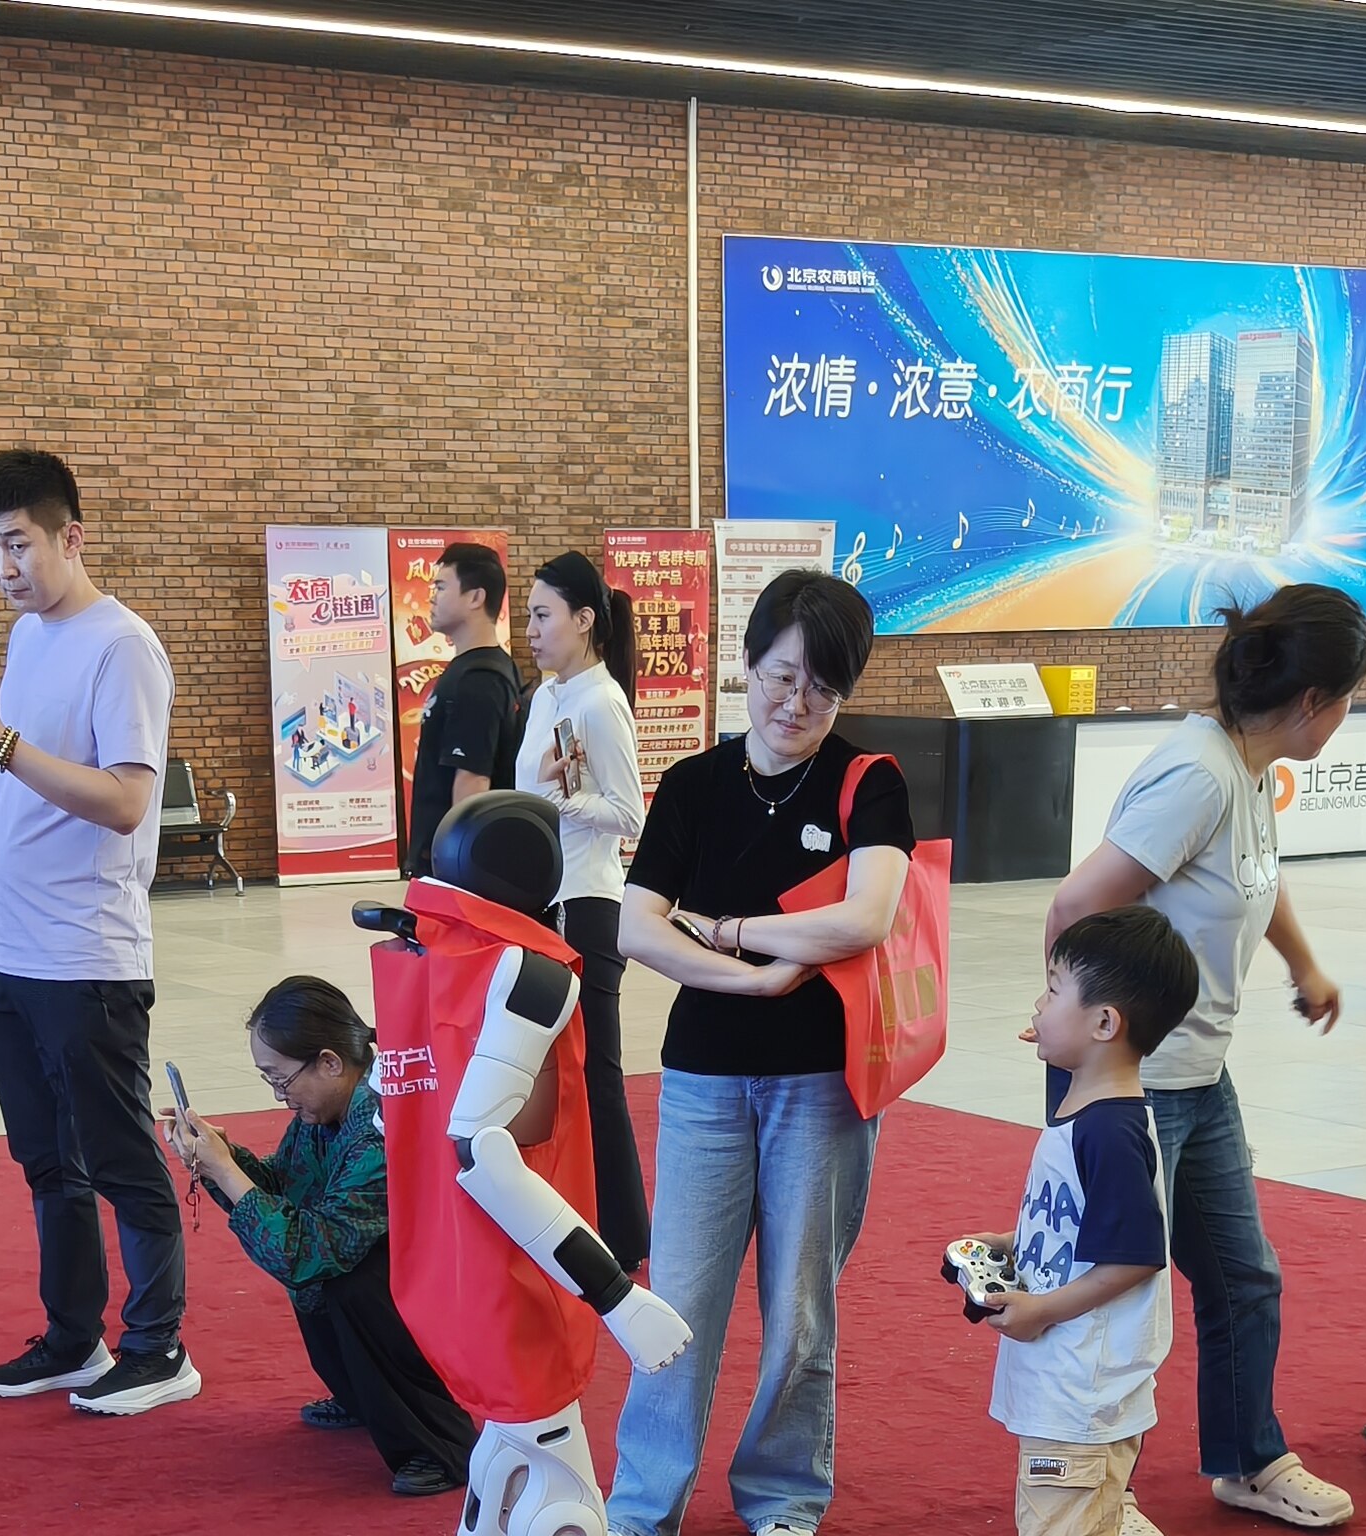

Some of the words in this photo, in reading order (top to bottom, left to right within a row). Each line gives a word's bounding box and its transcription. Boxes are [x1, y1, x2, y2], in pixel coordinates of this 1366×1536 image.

[787, 267, 875, 286] 北京农商银行
[633, 570, 683, 586] 存款产品
[288, 577, 331, 601] 农商
[312, 594, 375, 620] e链通
